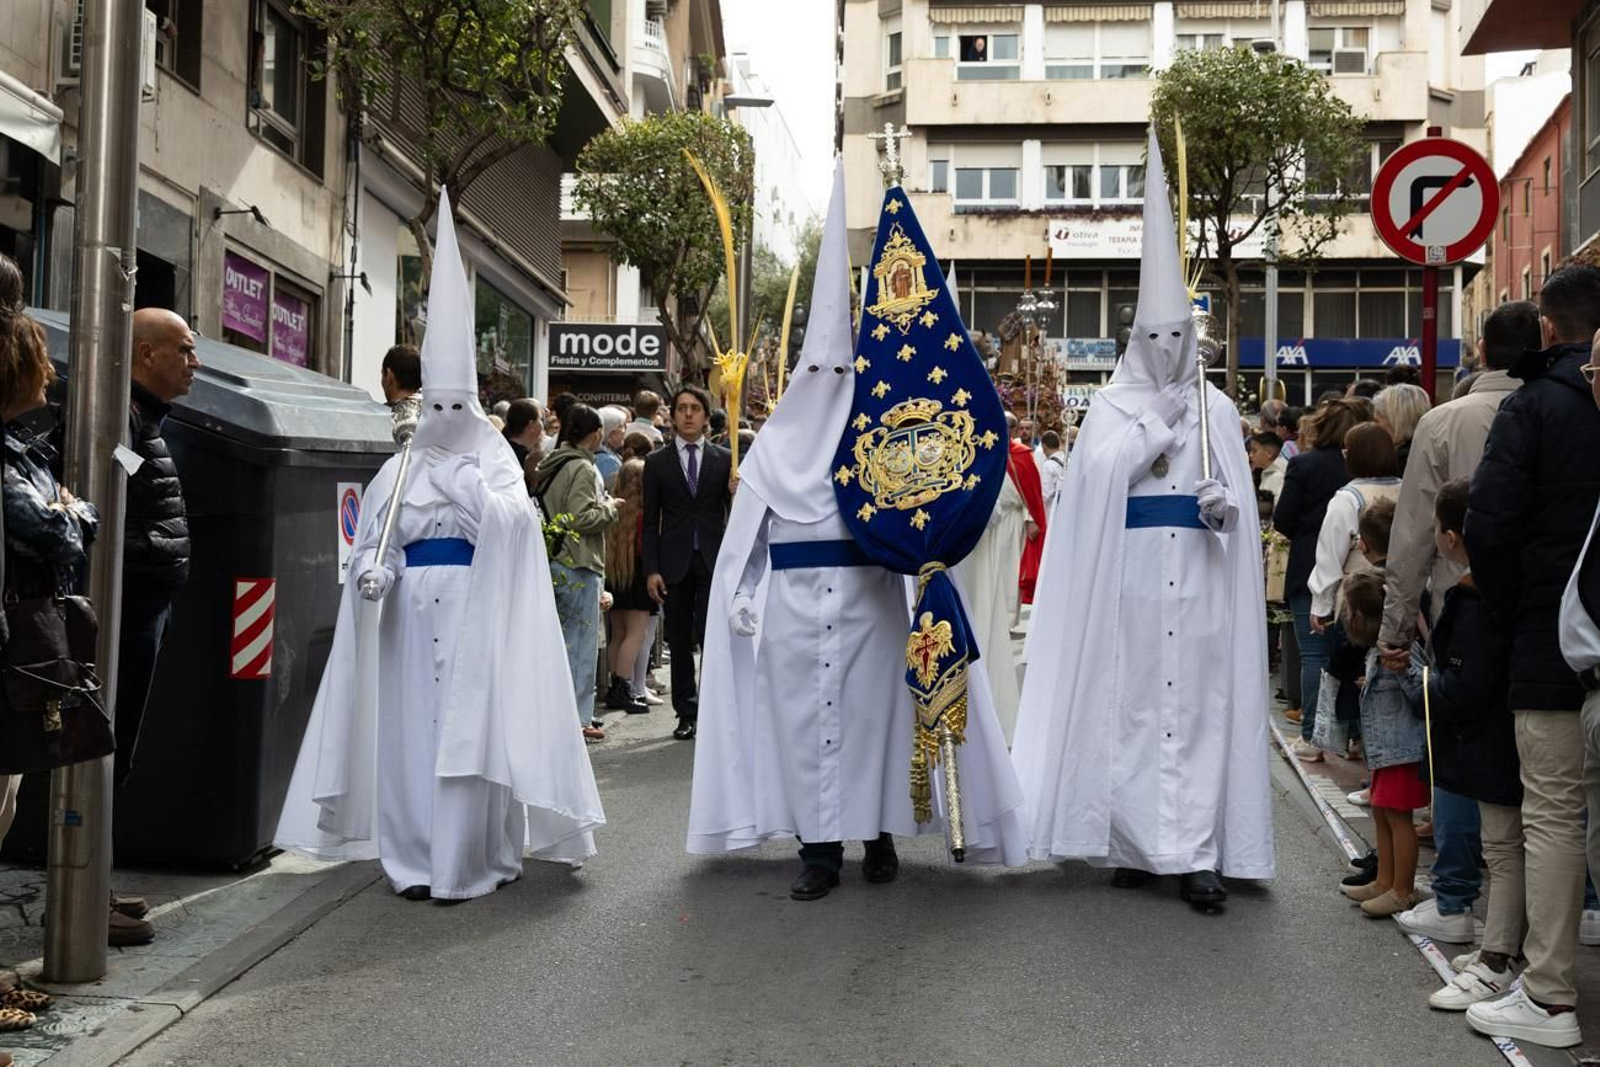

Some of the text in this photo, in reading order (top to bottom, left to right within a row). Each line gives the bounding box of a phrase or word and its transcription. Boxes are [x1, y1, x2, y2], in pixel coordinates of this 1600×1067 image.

[1108, 235, 1137, 244] TERAPIA
[226, 267, 262, 299] OUTLET
[272, 303, 304, 331] OUTLET
[560, 327, 660, 356] mode
[551, 355, 659, 367] Fiesta y Complementos
[1276, 342, 1309, 365] AXA
[1383, 342, 1422, 365] AXA
[577, 393, 631, 402] CONFITERIA
